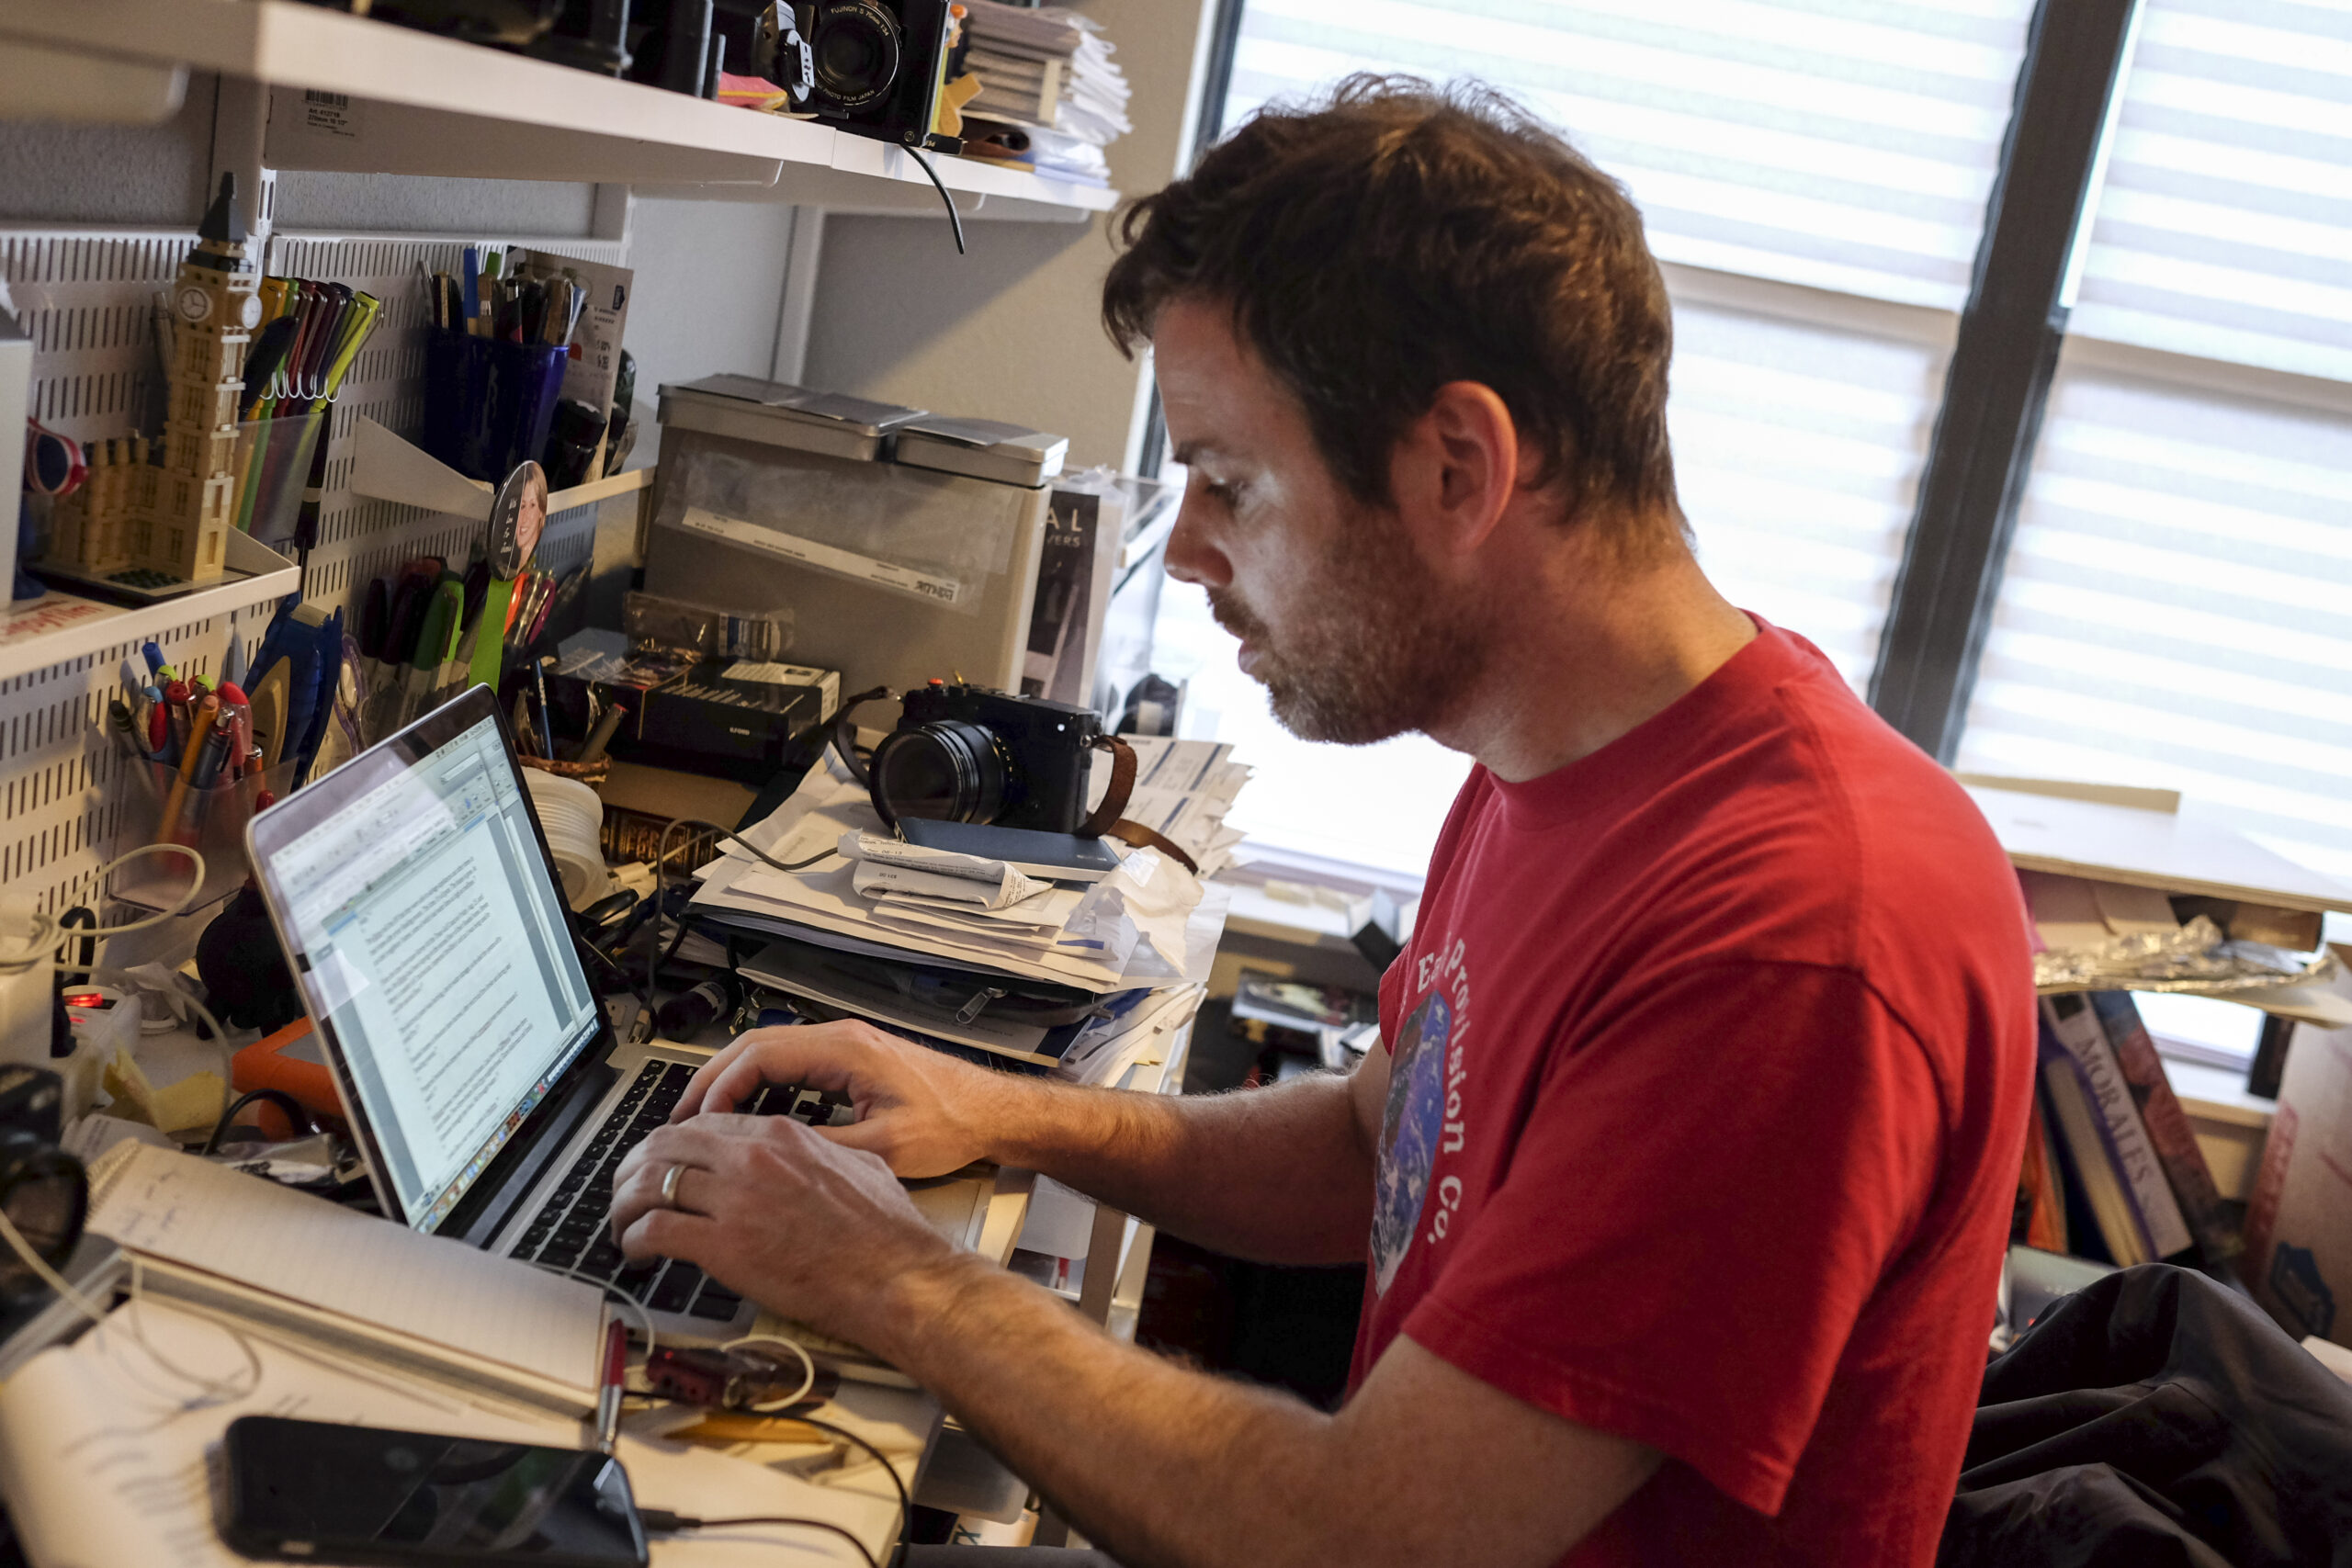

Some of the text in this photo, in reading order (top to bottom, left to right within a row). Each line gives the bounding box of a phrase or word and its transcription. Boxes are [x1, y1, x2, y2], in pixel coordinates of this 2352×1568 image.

[831, 6, 857, 15] FUJINON
[823, 88, 842, 100] PHOTO
[858, 89, 876, 100] JAPAN
[1443, 938, 1471, 1154] Provision
[2074, 1035, 2154, 1184] MORALES
[1427, 1174, 1463, 1245] Co.
